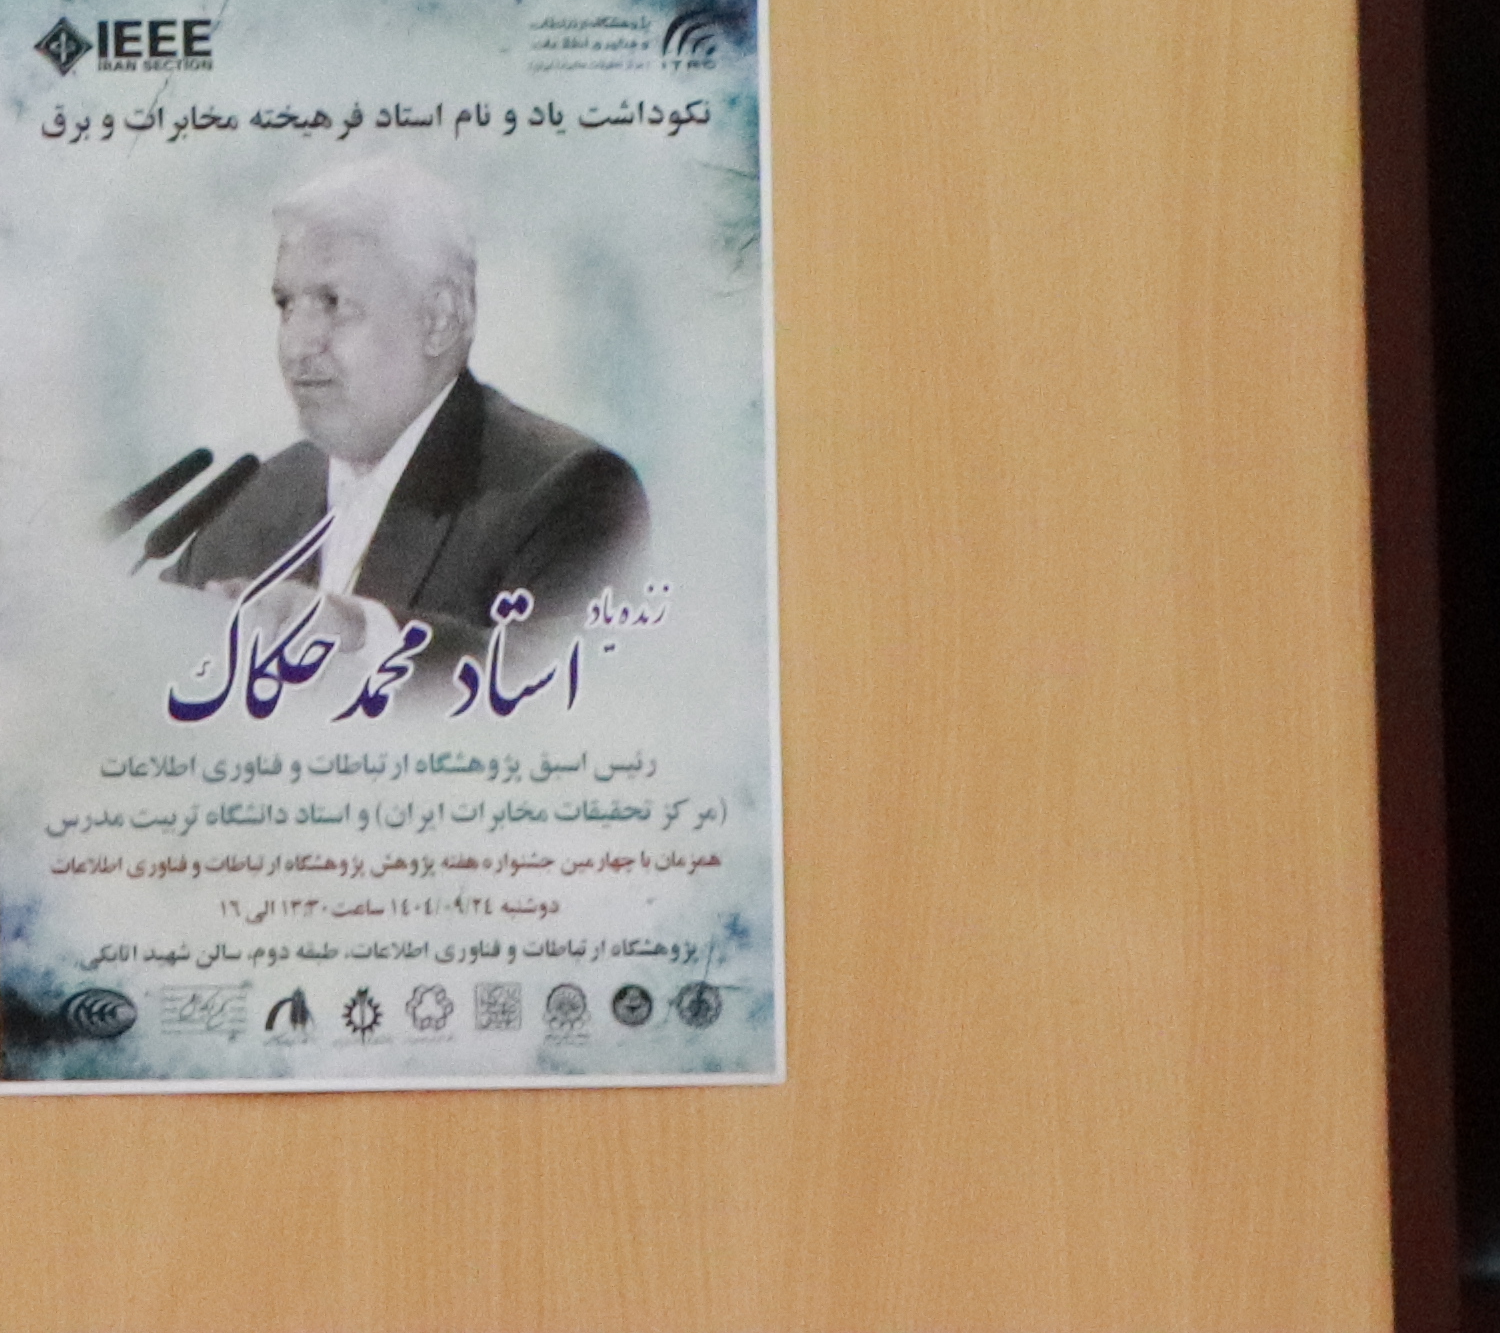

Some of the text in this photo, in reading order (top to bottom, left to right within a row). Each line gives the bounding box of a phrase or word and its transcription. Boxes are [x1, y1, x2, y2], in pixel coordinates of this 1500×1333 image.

[97, 19, 212, 58] IEEE
[98, 59, 213, 71] IRAN SECTION
[41, 99, 711, 143] نکوداشت یاد و نام استاد فرهیخته مخابرات و برق
[449, 592, 581, 718] استاد
[331, 624, 431, 722] محمد
[100, 754, 196, 778] اطلاعات
[202, 754, 282, 783] فناوری
[289, 760, 301, 782] و
[307, 752, 409, 782] ارتباطات
[415, 752, 521, 782] پژوهشگاه
[530, 752, 586, 782] اسبق
[45, 796, 728, 837] (مرکز تحقیقات مخابرات ایران) و استاد دانشگاه تربیت مدرس
[51, 855, 122, 874] اطلاعات
[126, 853, 187, 878] فناوری
[192, 860, 200, 877] و
[204, 855, 280, 876] ارتباطات
[284, 853, 365, 878] پژوهشگاه
[370, 852, 435, 878] پژوهش
[441, 852, 479, 871] هفته
[484, 851, 554, 876] جشنواره
[560, 852, 635, 876] چهارمین
[655, 850, 721, 875] همزمان
[330, 898, 384, 918] ساعت
[501, 898, 560, 920] دوشنبه
[143, 940, 190, 966] شهید
[196, 944, 241, 969] سالن
[296, 942, 338, 962] طبقه
[435, 939, 500, 964] فناوری
[507, 945, 516, 964] و
[522, 938, 606, 963] ارتباطات
[611, 937, 698, 964] پژوهشگاه
